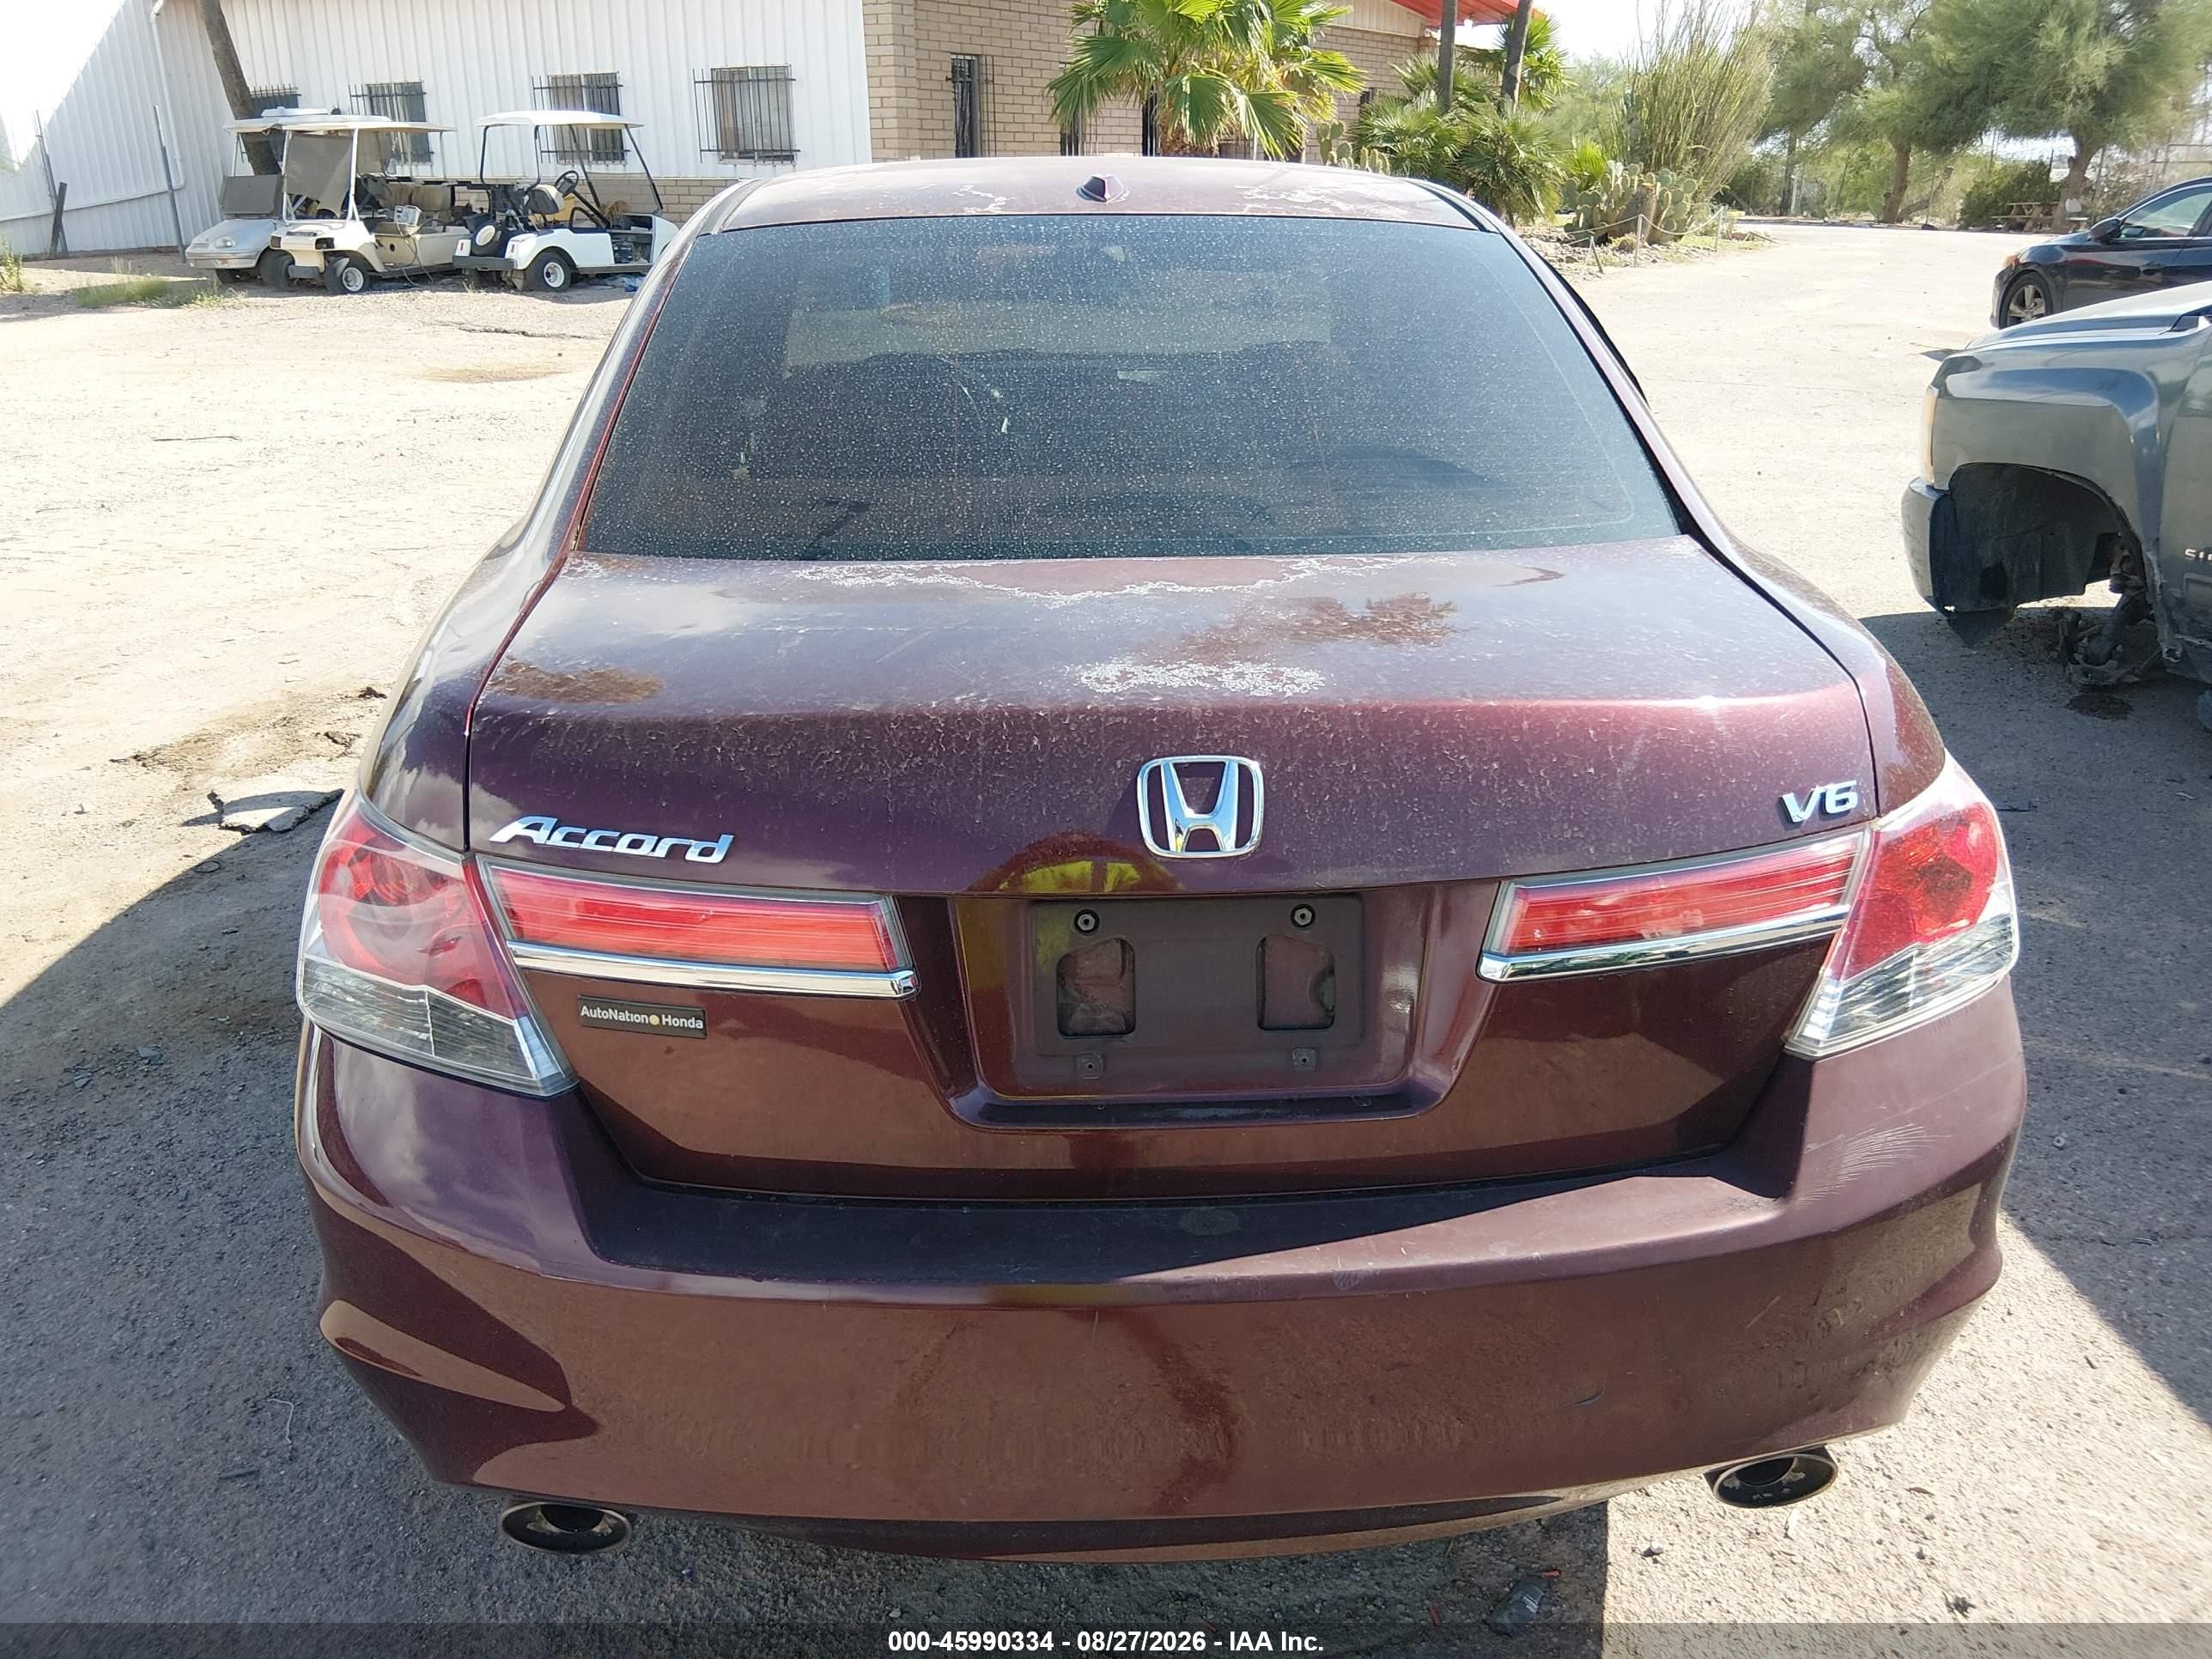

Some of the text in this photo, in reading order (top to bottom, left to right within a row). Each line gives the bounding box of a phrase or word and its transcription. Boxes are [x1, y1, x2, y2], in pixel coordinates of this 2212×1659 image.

[1780, 779, 1859, 823] V6
[489, 815, 734, 864] Accord
[580, 1005, 704, 1030] AutoNation Honda
